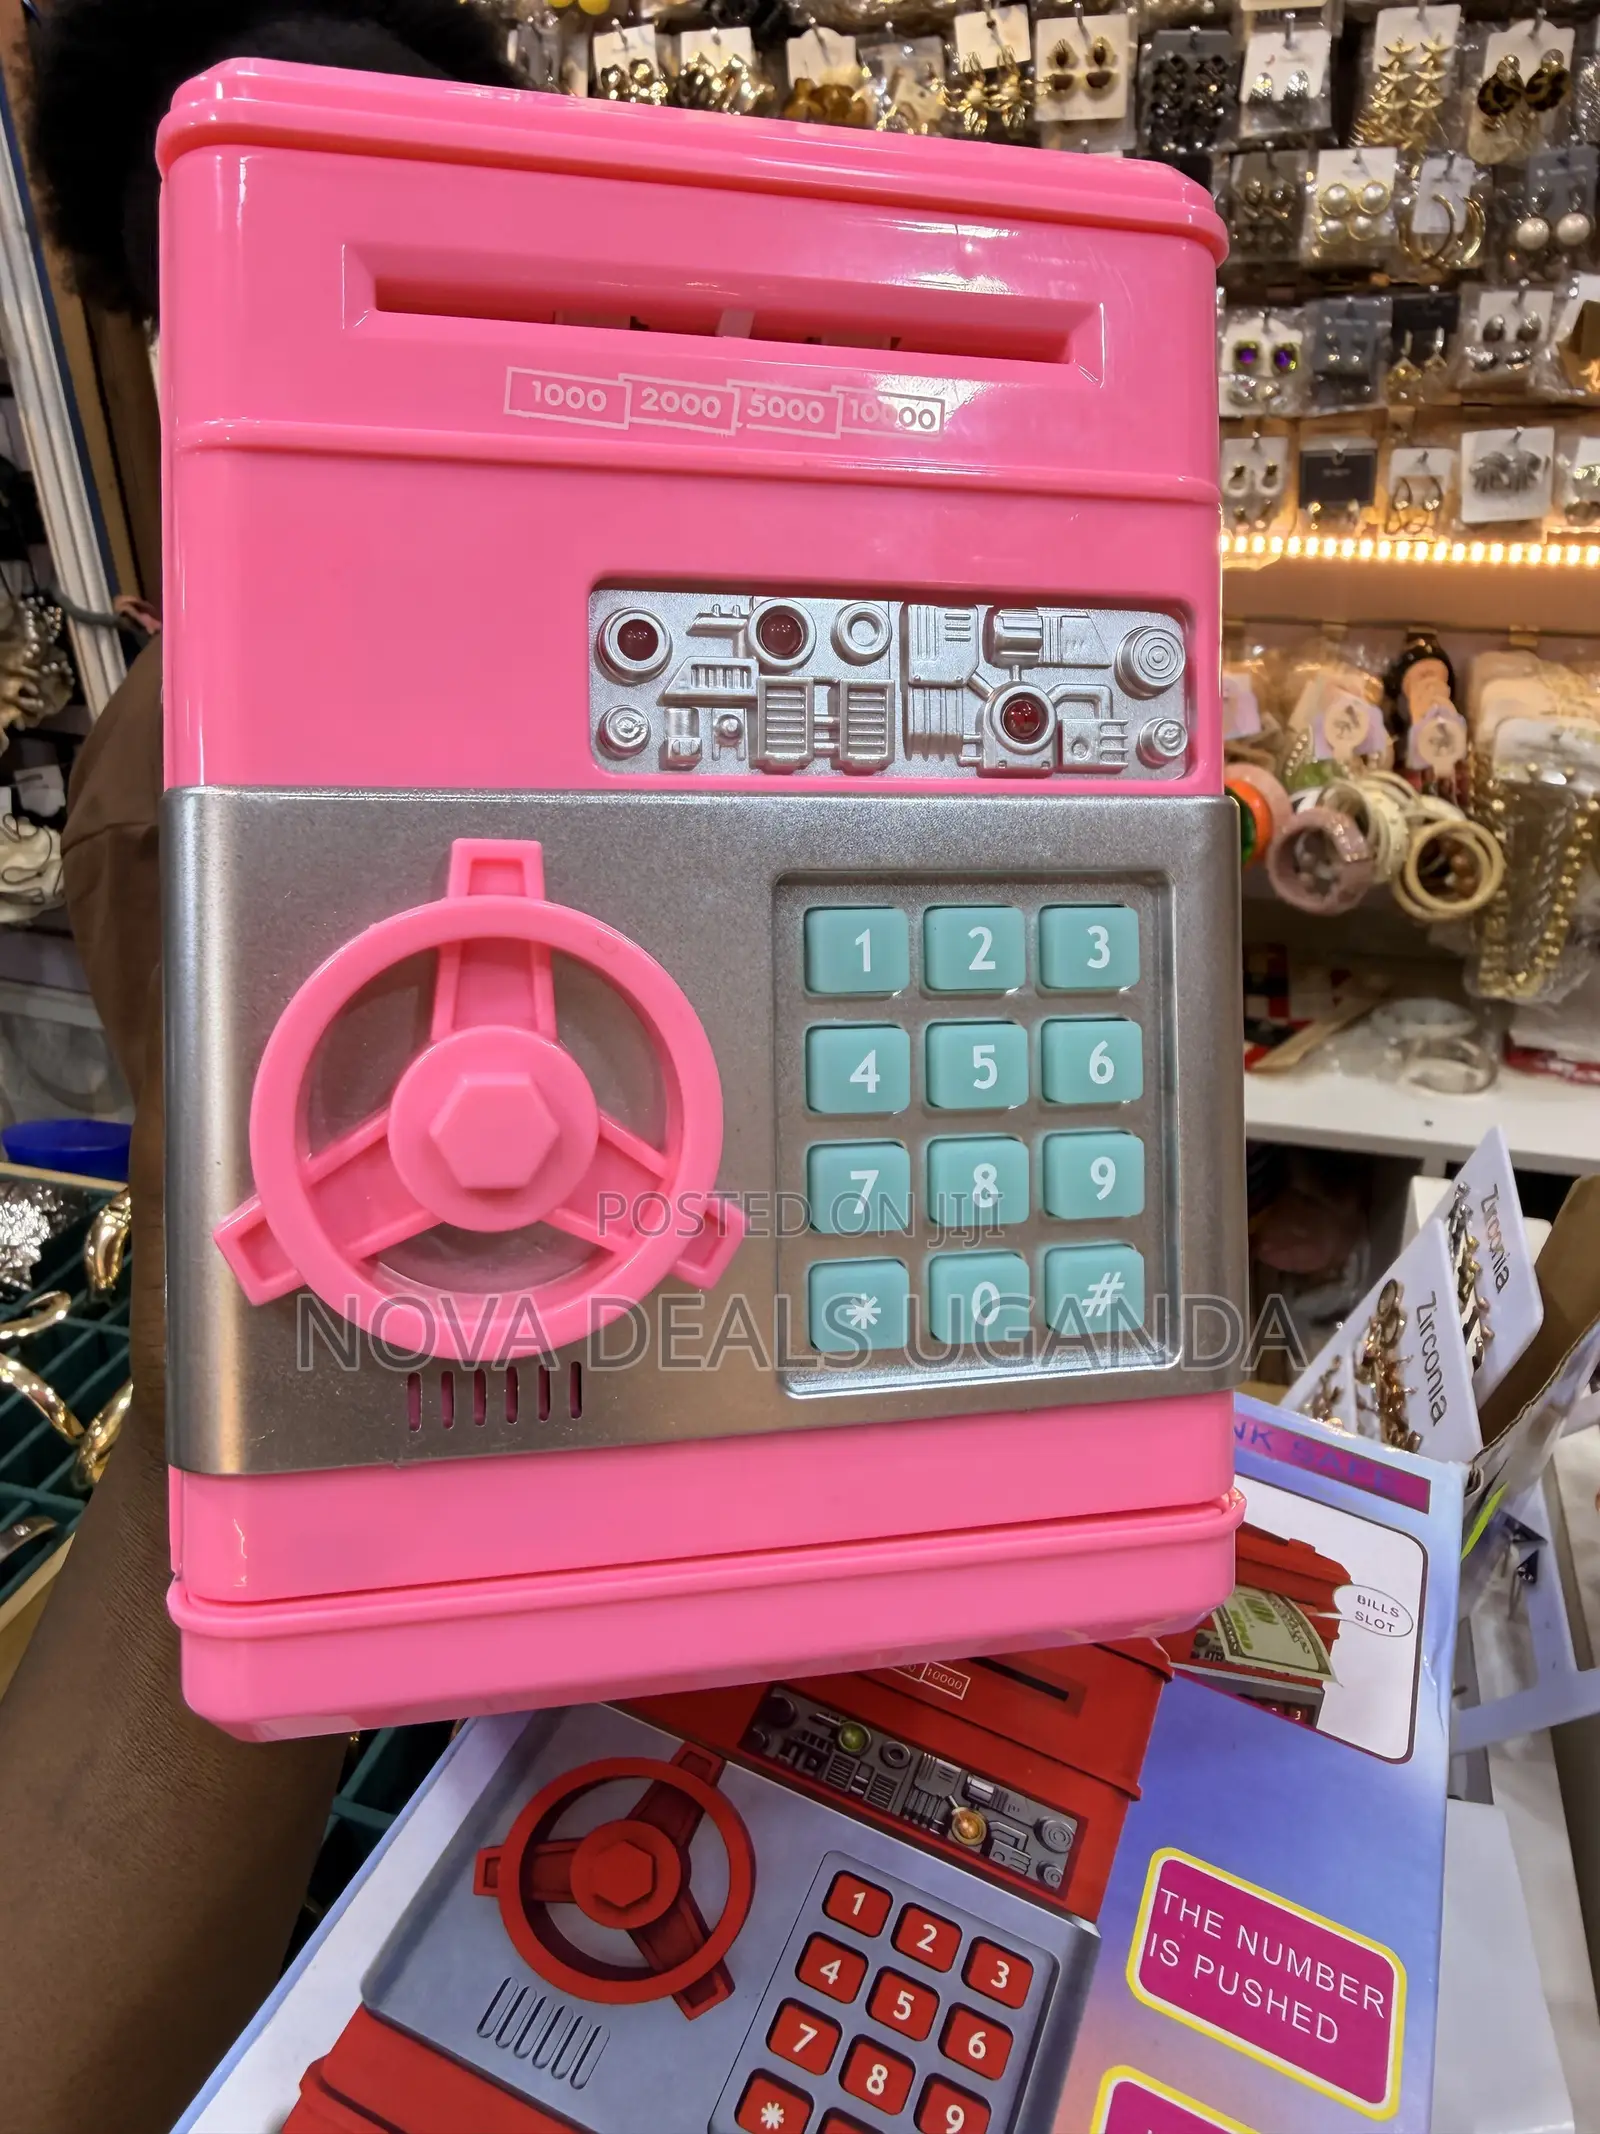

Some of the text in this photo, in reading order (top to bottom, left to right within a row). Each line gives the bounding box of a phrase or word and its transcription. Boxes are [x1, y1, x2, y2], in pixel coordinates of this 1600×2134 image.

[531, 380, 607, 412] 1000
[640, 387, 721, 419] 2000
[747, 397, 825, 424] 5000
[855, 925, 1111, 972] 1 2 3
[850, 1040, 1115, 1093] 4 5 6
[850, 1156, 1116, 1214] 7 8 9
[971, 1281, 999, 1326] 0
[1416, 1291, 1449, 1427] Zirconia
[1354, 1611, 1395, 1633] SLOT
[1357, 1594, 1400, 1618] BILLS
[926, 1667, 963, 1690] 10000
[852, 1891, 1010, 1989] 1 2 3
[1160, 1888, 1385, 2018] THE NUMBER
[820, 1959, 986, 2060] 4 5 6
[1149, 1933, 1338, 2044] IS PUSHED
[792, 2023, 965, 2134] 7 8 9
